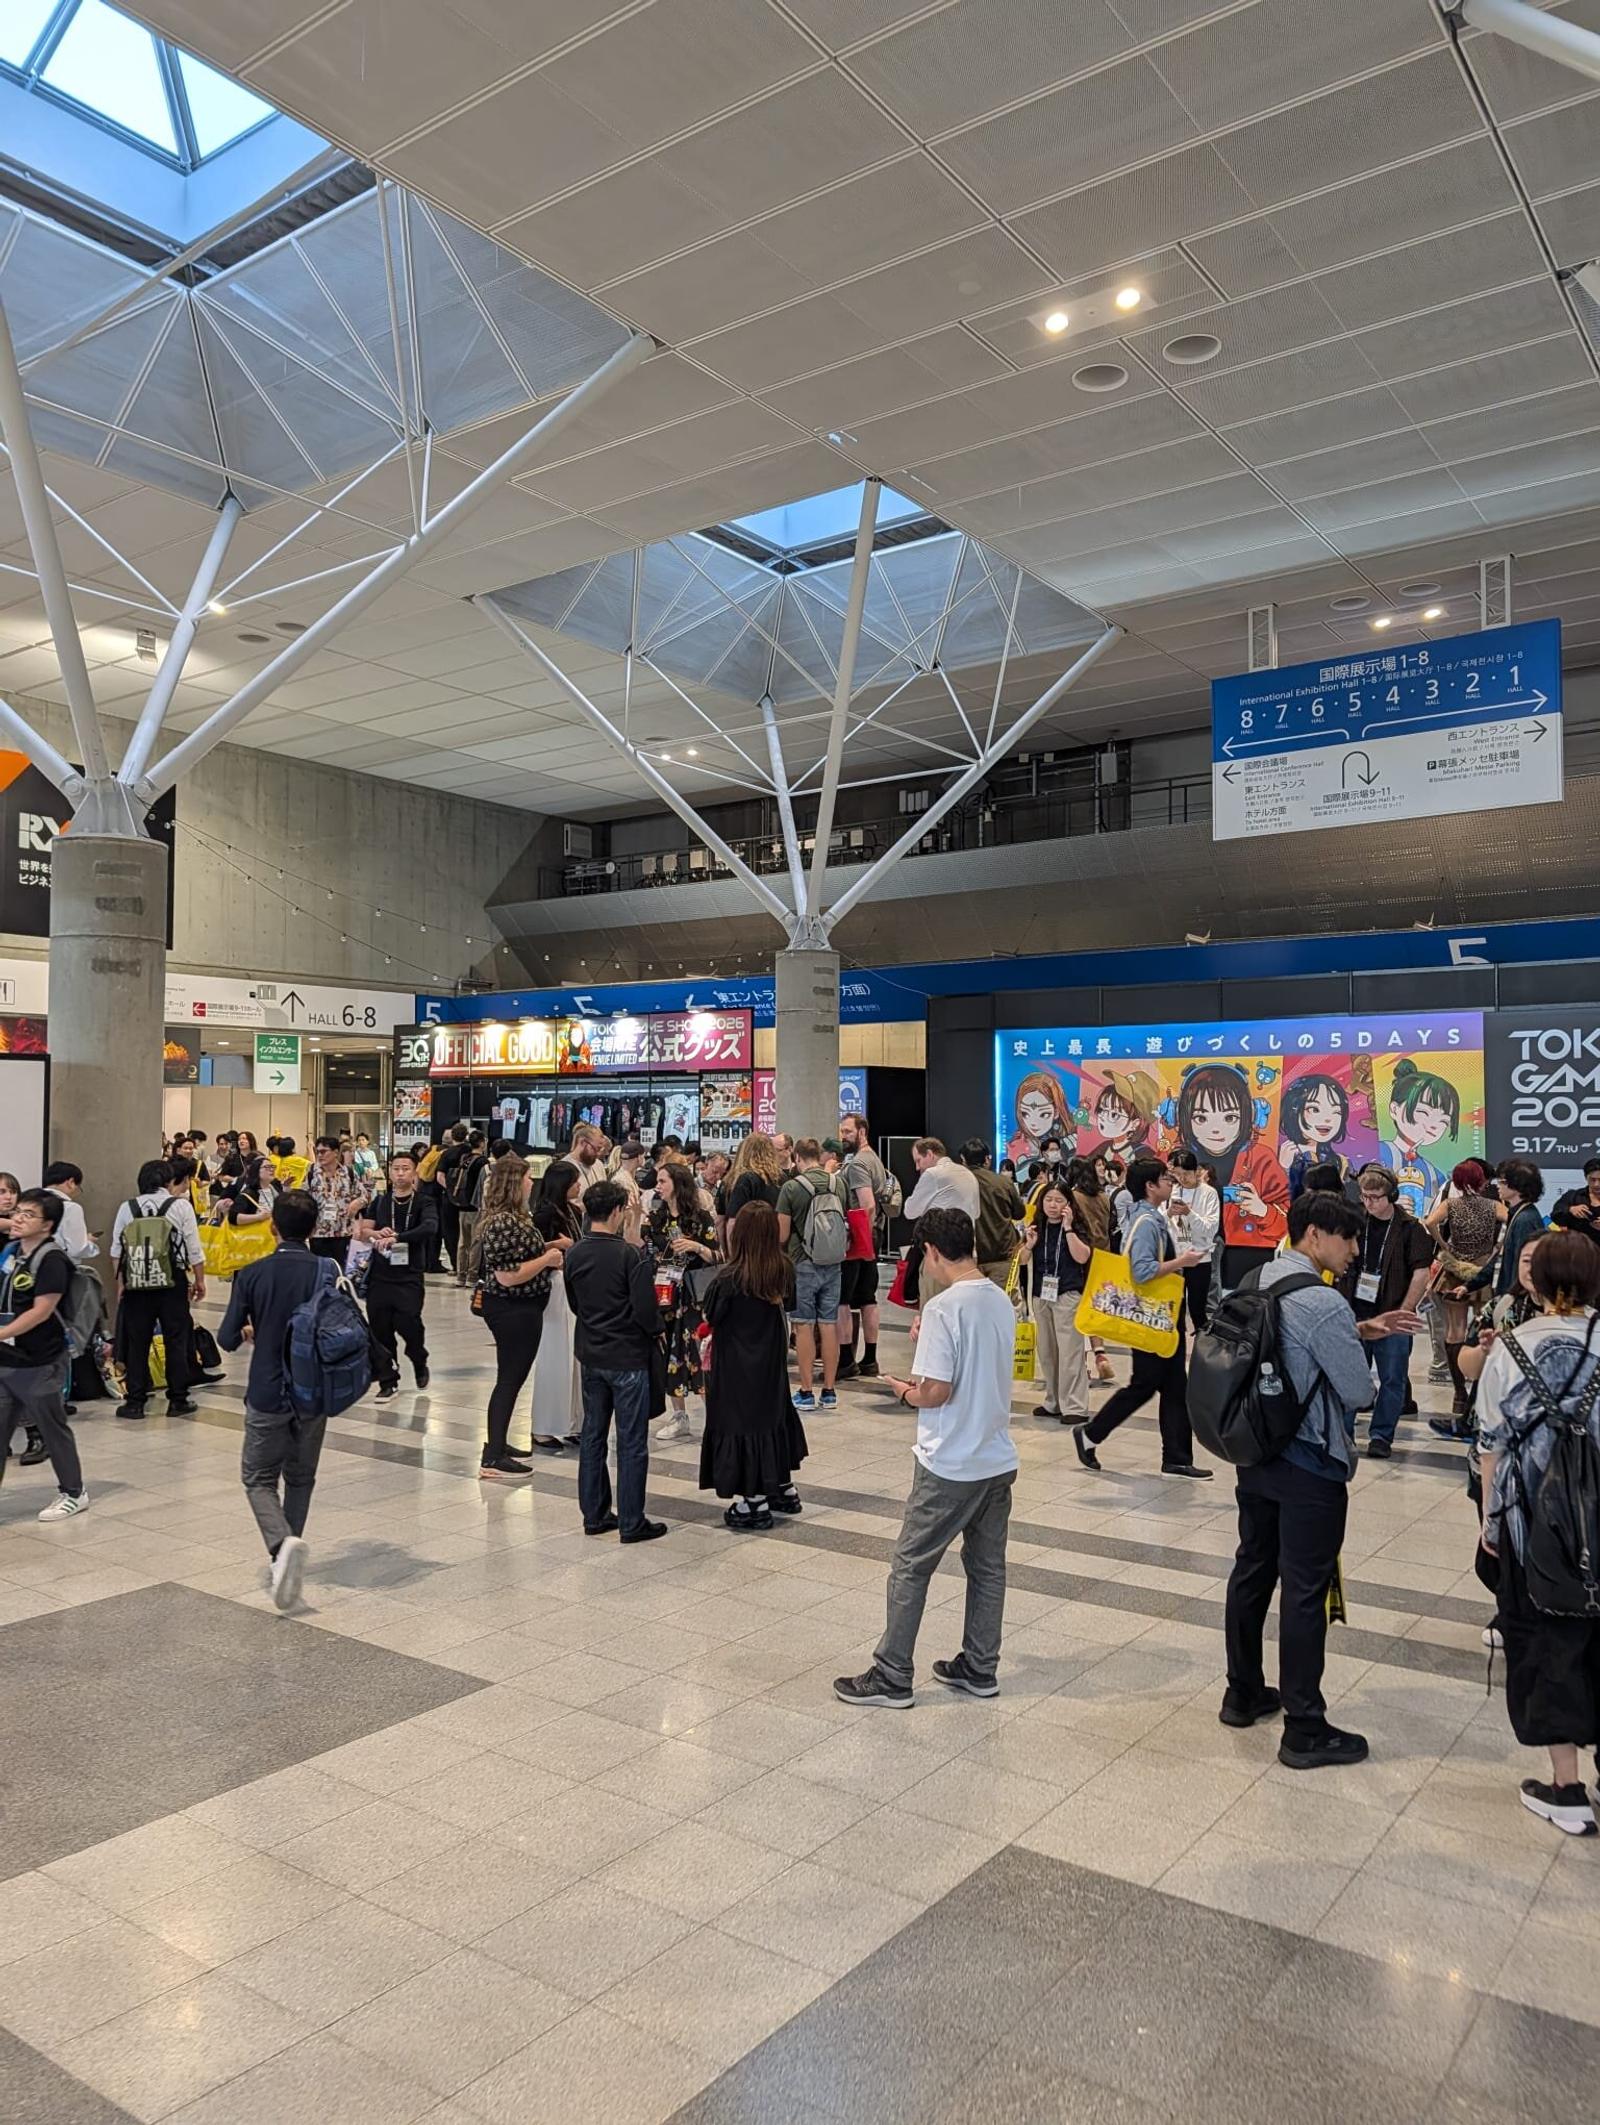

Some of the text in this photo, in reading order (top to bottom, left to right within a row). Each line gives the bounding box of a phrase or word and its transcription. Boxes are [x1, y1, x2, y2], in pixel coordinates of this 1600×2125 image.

[1319, 651, 1429, 683] 国際展示場 1-8
[1239, 689, 1294, 706] International
[1296, 683, 1339, 697] Exhibition
[1342, 679, 1359, 689] Hall
[1241, 665, 1520, 728] 8 7 6 5 4 3 2 1
[1447, 722, 1520, 741] 西エントランス
[1244, 779, 1306, 795] 東エントランス
[716, 990, 776, 1003] 東エントラ
[308, 1004, 377, 1028] HALL 6-8
[425, 1001, 442, 1025] 5
[434, 1032, 506, 1065] OFFICIAL
[638, 1031, 745, 1063] 公式グッズ
